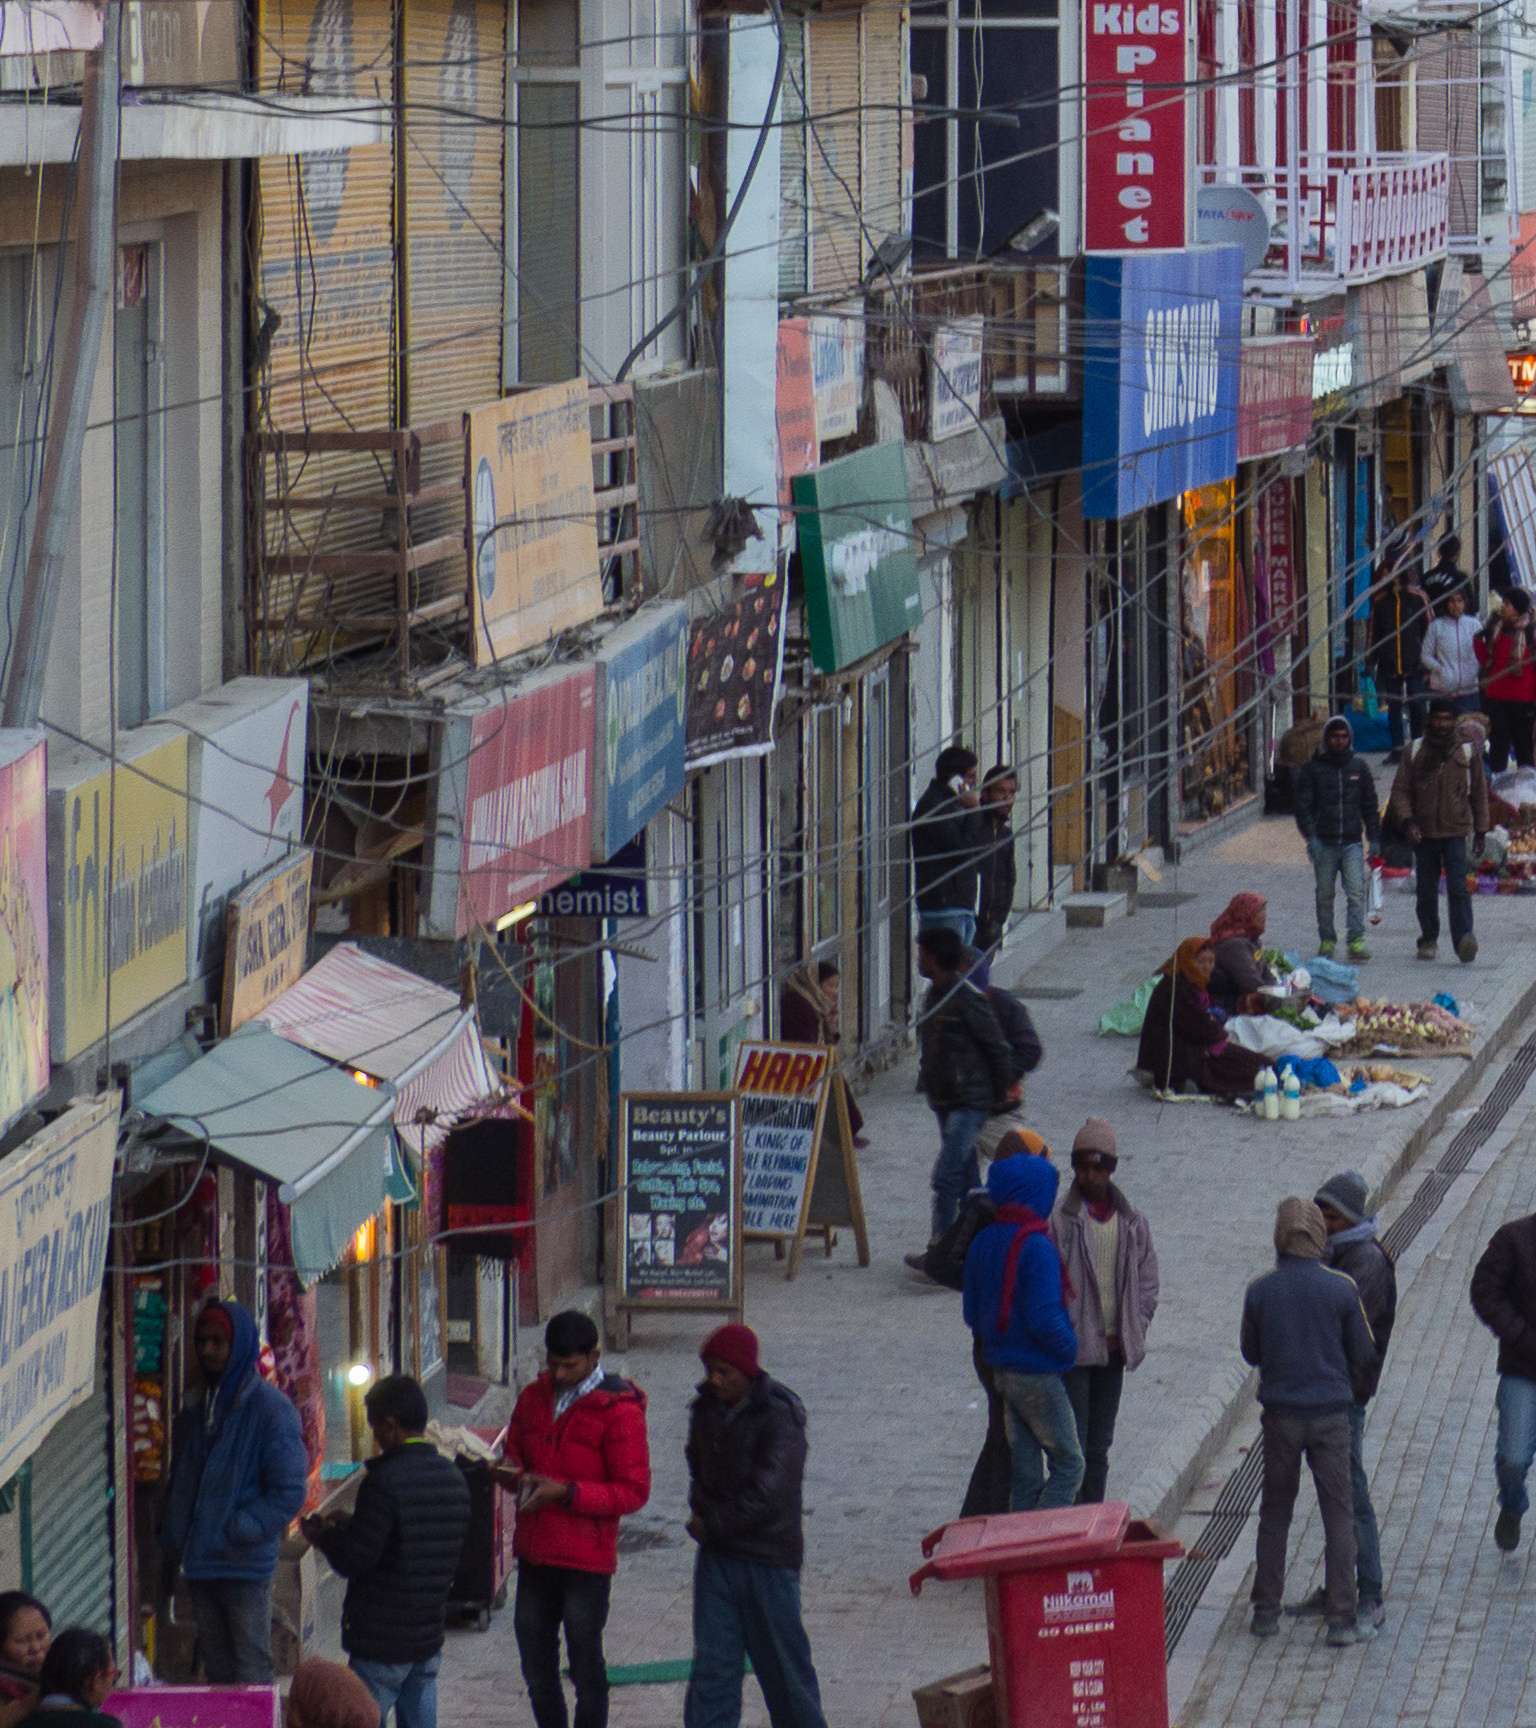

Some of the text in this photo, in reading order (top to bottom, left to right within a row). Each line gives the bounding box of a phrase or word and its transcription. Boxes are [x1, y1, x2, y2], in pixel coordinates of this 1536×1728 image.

[1093, 3, 1180, 35] Kids
[1142, 298, 1220, 439] SAMSUNG
[538, 884, 641, 914] hemist
[739, 1050, 825, 1095] HARI
[632, 1106, 727, 1128] Beauty's
[632, 1127, 727, 1144] Beauty Parlour
[1042, 1589, 1115, 1612] Nilkamal
[1038, 1620, 1115, 1638] GO GREEN
